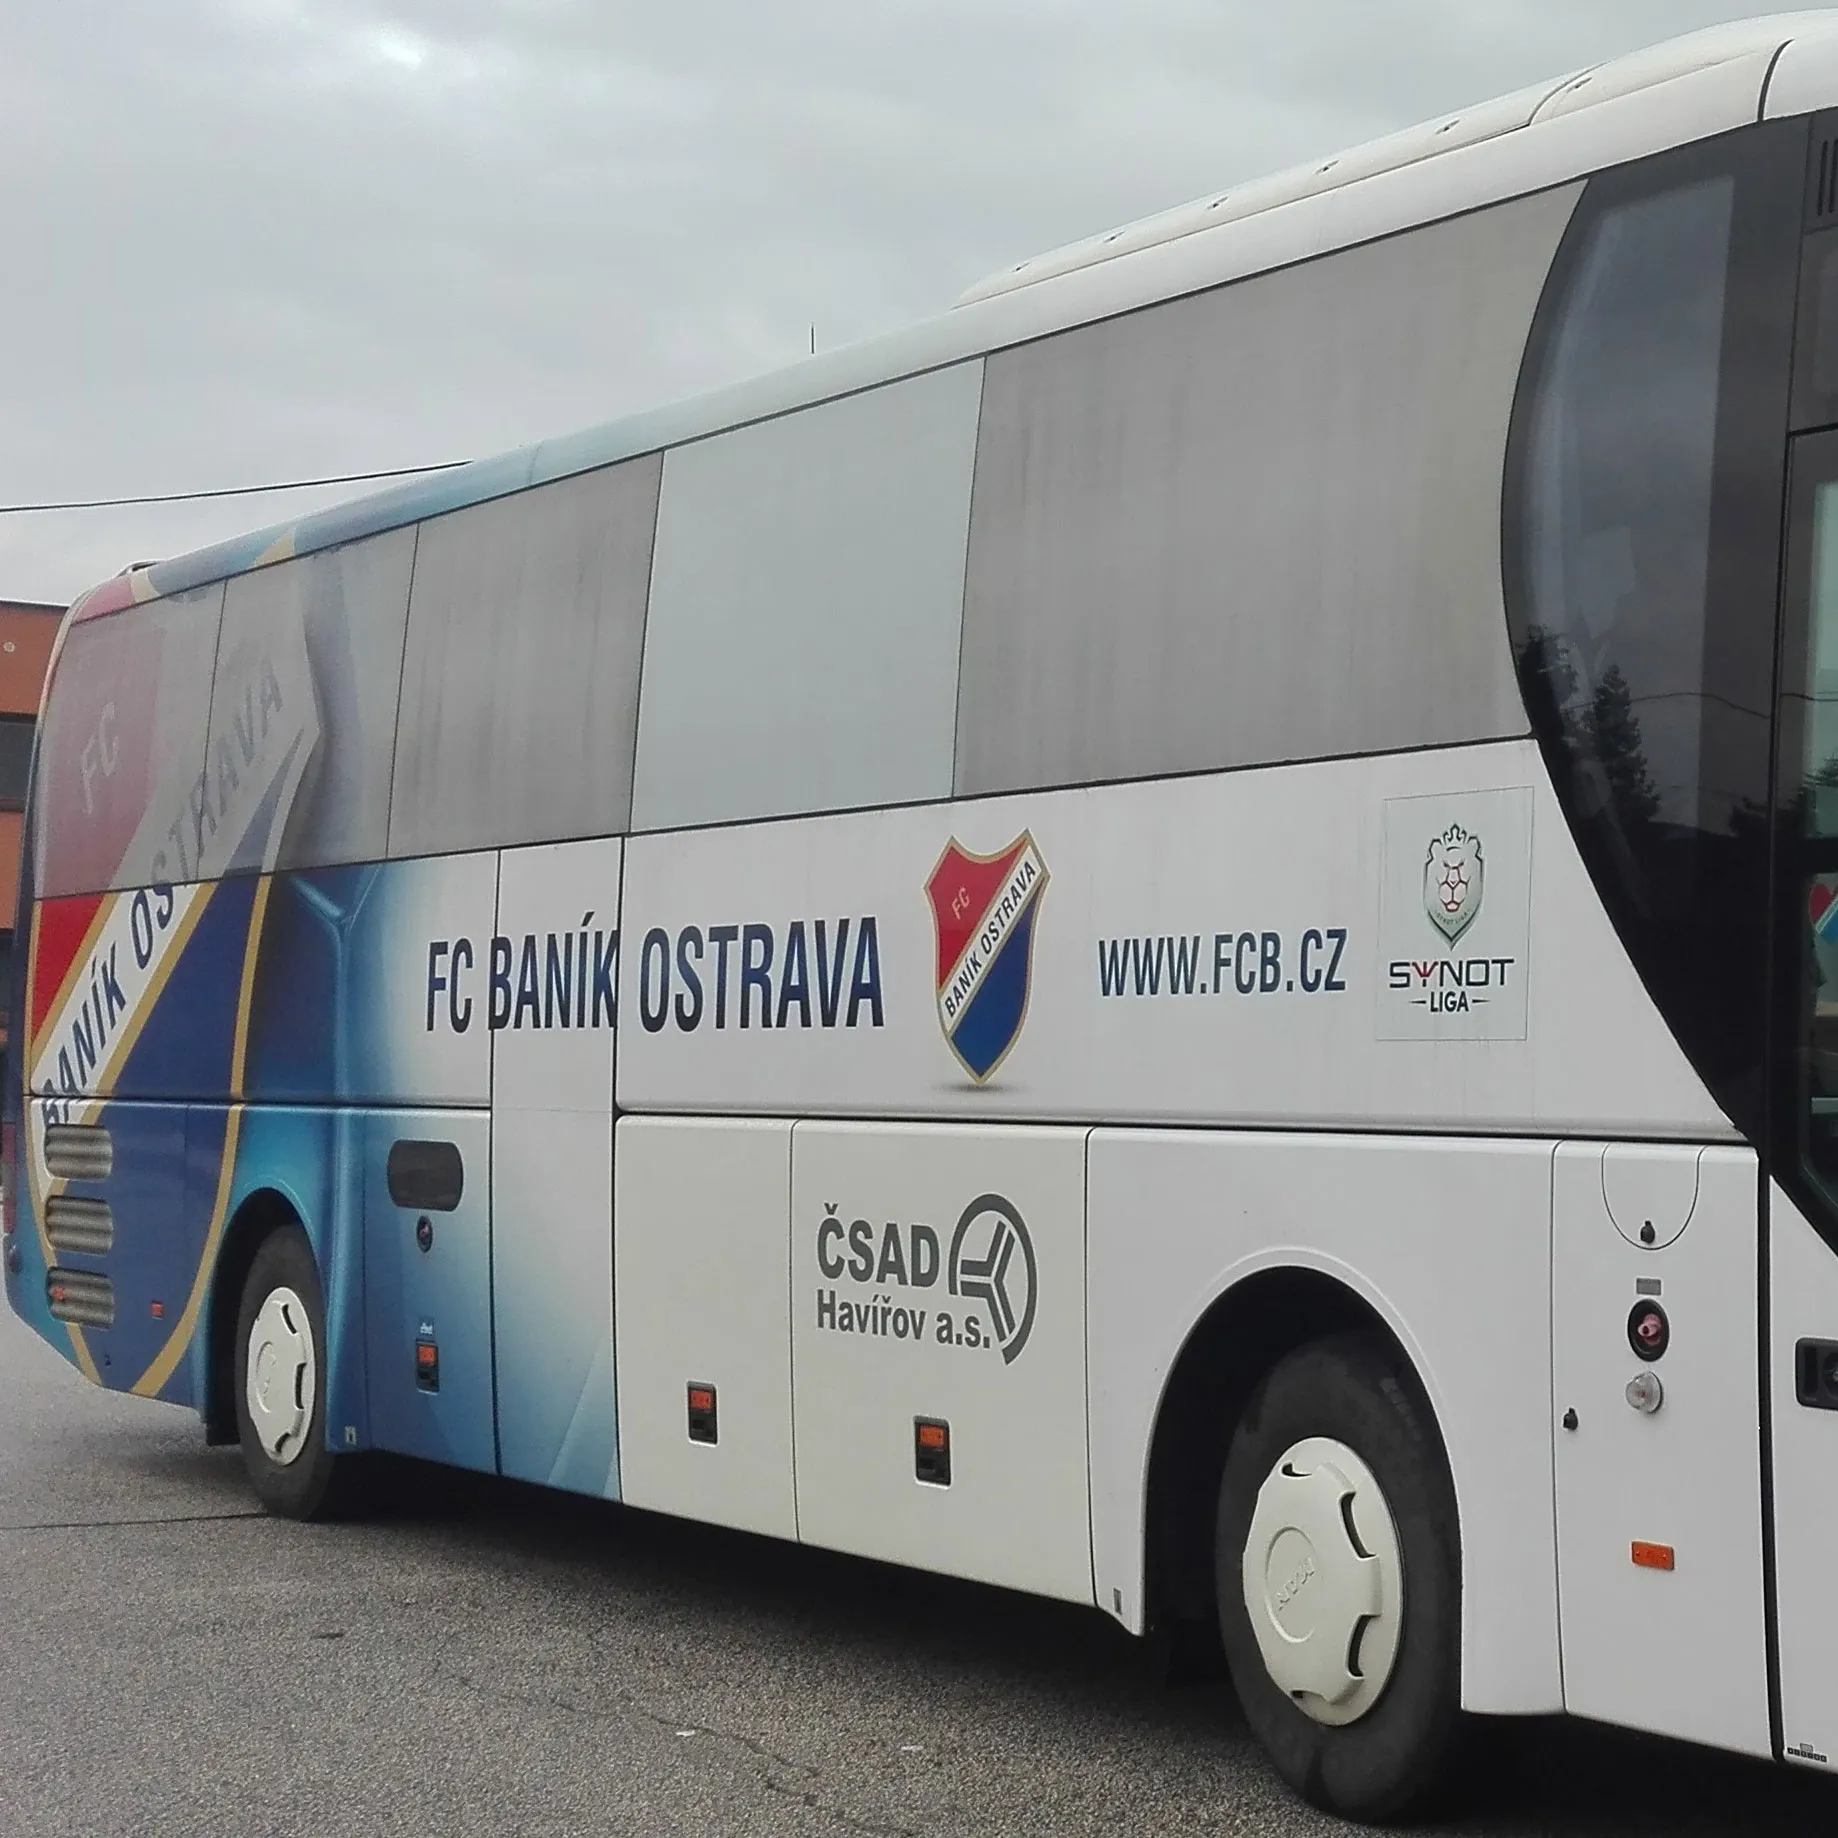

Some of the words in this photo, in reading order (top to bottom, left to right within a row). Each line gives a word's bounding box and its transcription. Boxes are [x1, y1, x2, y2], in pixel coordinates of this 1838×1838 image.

[952, 887, 971, 920] FC
[944, 951, 983, 1018] BANÍK
[980, 860, 1037, 956] OSTRAVA
[1098, 928, 1349, 996] WWW.FCB.CZ
[426, 937, 474, 1034] FC
[488, 910, 619, 1031] BANÍK
[640, 916, 886, 1034] OSTRAVA
[1389, 958, 1515, 989] SYNOT
[1430, 990, 1470, 1013] LIGA
[816, 1202, 941, 1288] ČSAD
[816, 1288, 927, 1341] Havířov
[936, 1311, 991, 1349] a.s.
